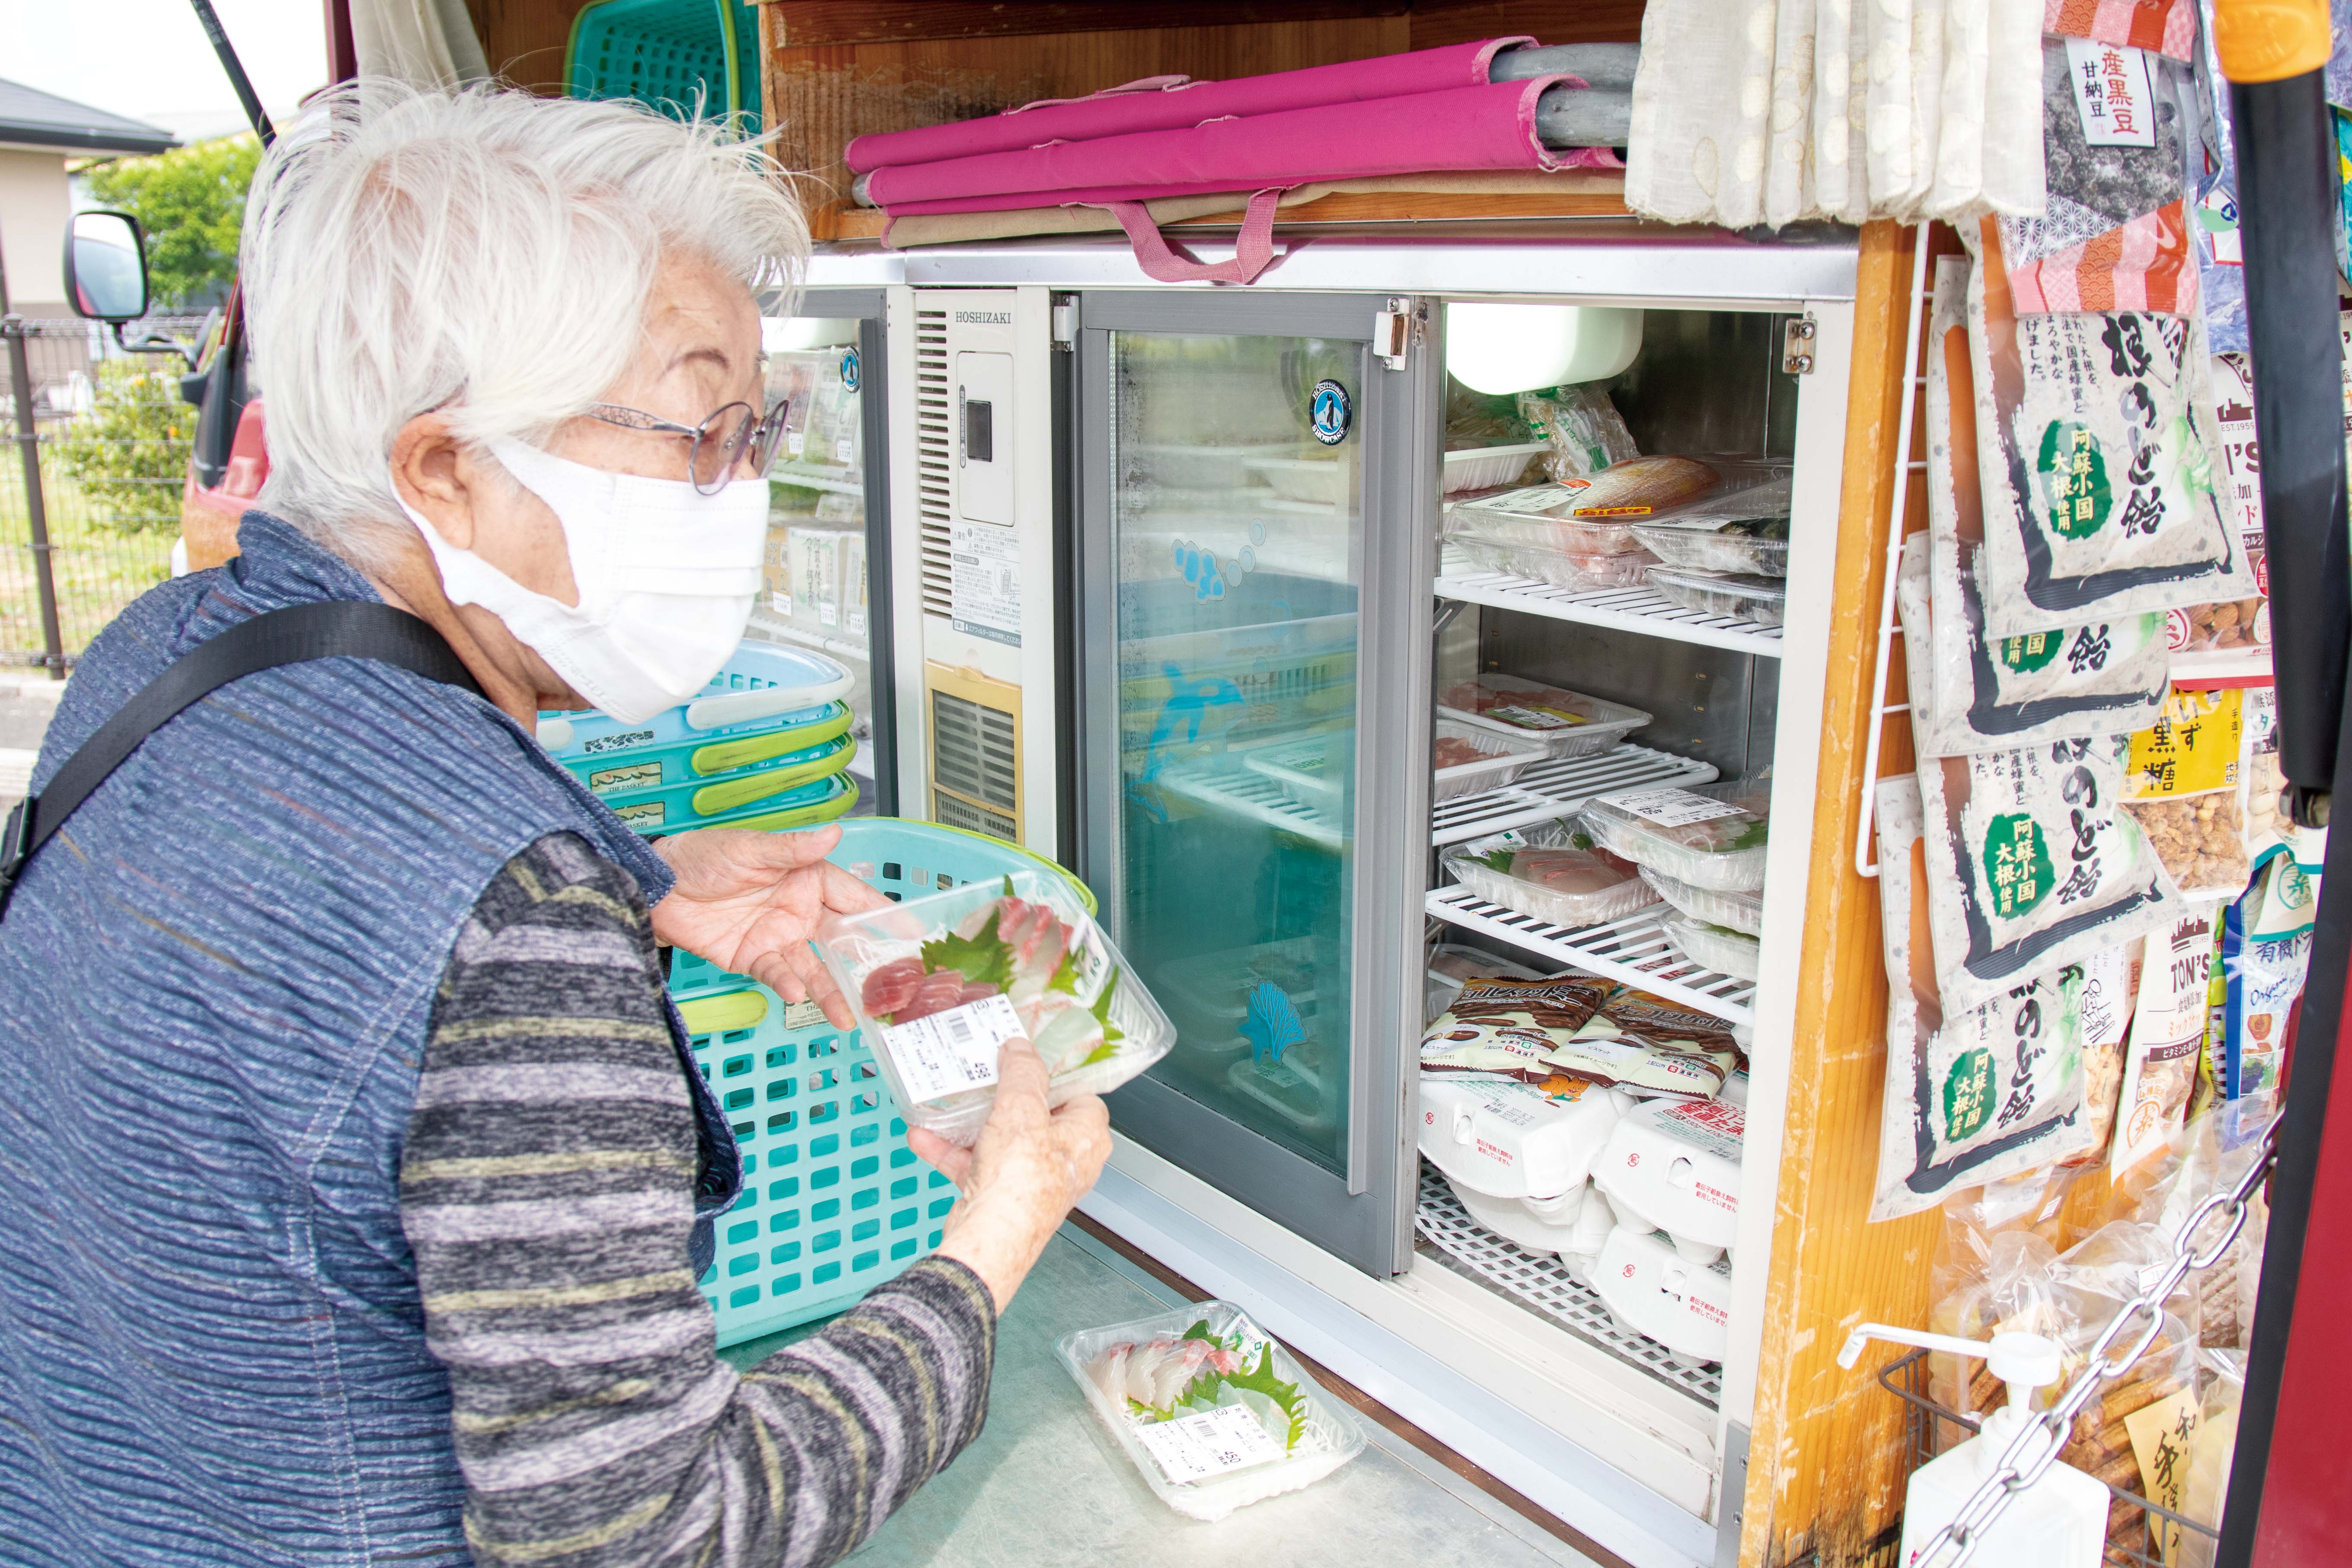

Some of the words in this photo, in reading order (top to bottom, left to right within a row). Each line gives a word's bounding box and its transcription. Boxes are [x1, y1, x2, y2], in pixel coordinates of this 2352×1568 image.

[2081, 61, 2106, 117] 甘納豆
[2099, 42, 2139, 134] 産黒豆
[955, 311, 1011, 323] HOSHIZAKI
[2026, 318, 2046, 380] げました。
[1312, 425, 1346, 443] SHOWCASE
[2050, 451, 2073, 531] 大根使用
[2071, 429, 2094, 521] 阿蘇小国
[2068, 624, 2110, 675] 飴
[2175, 690, 2202, 751] いず
[2144, 716, 2176, 791] 黒糖
[622, 782, 645, 790] BASKET
[1994, 843, 2017, 914] 大根使用
[2013, 818, 2036, 904] 阿蘇小国
[2171, 953, 2211, 993] TON'S
[1588, 1045, 1611, 1055] ビスケット
[1950, 1077, 1972, 1138] 大根使用
[1964, 1052, 1990, 1129] 阿蘇小国
[1476, 1138, 1513, 1161] 遺伝子組換え飼料は
[1478, 1146, 1511, 1167] 使用していません
[1221, 1449, 1242, 1464] 450
